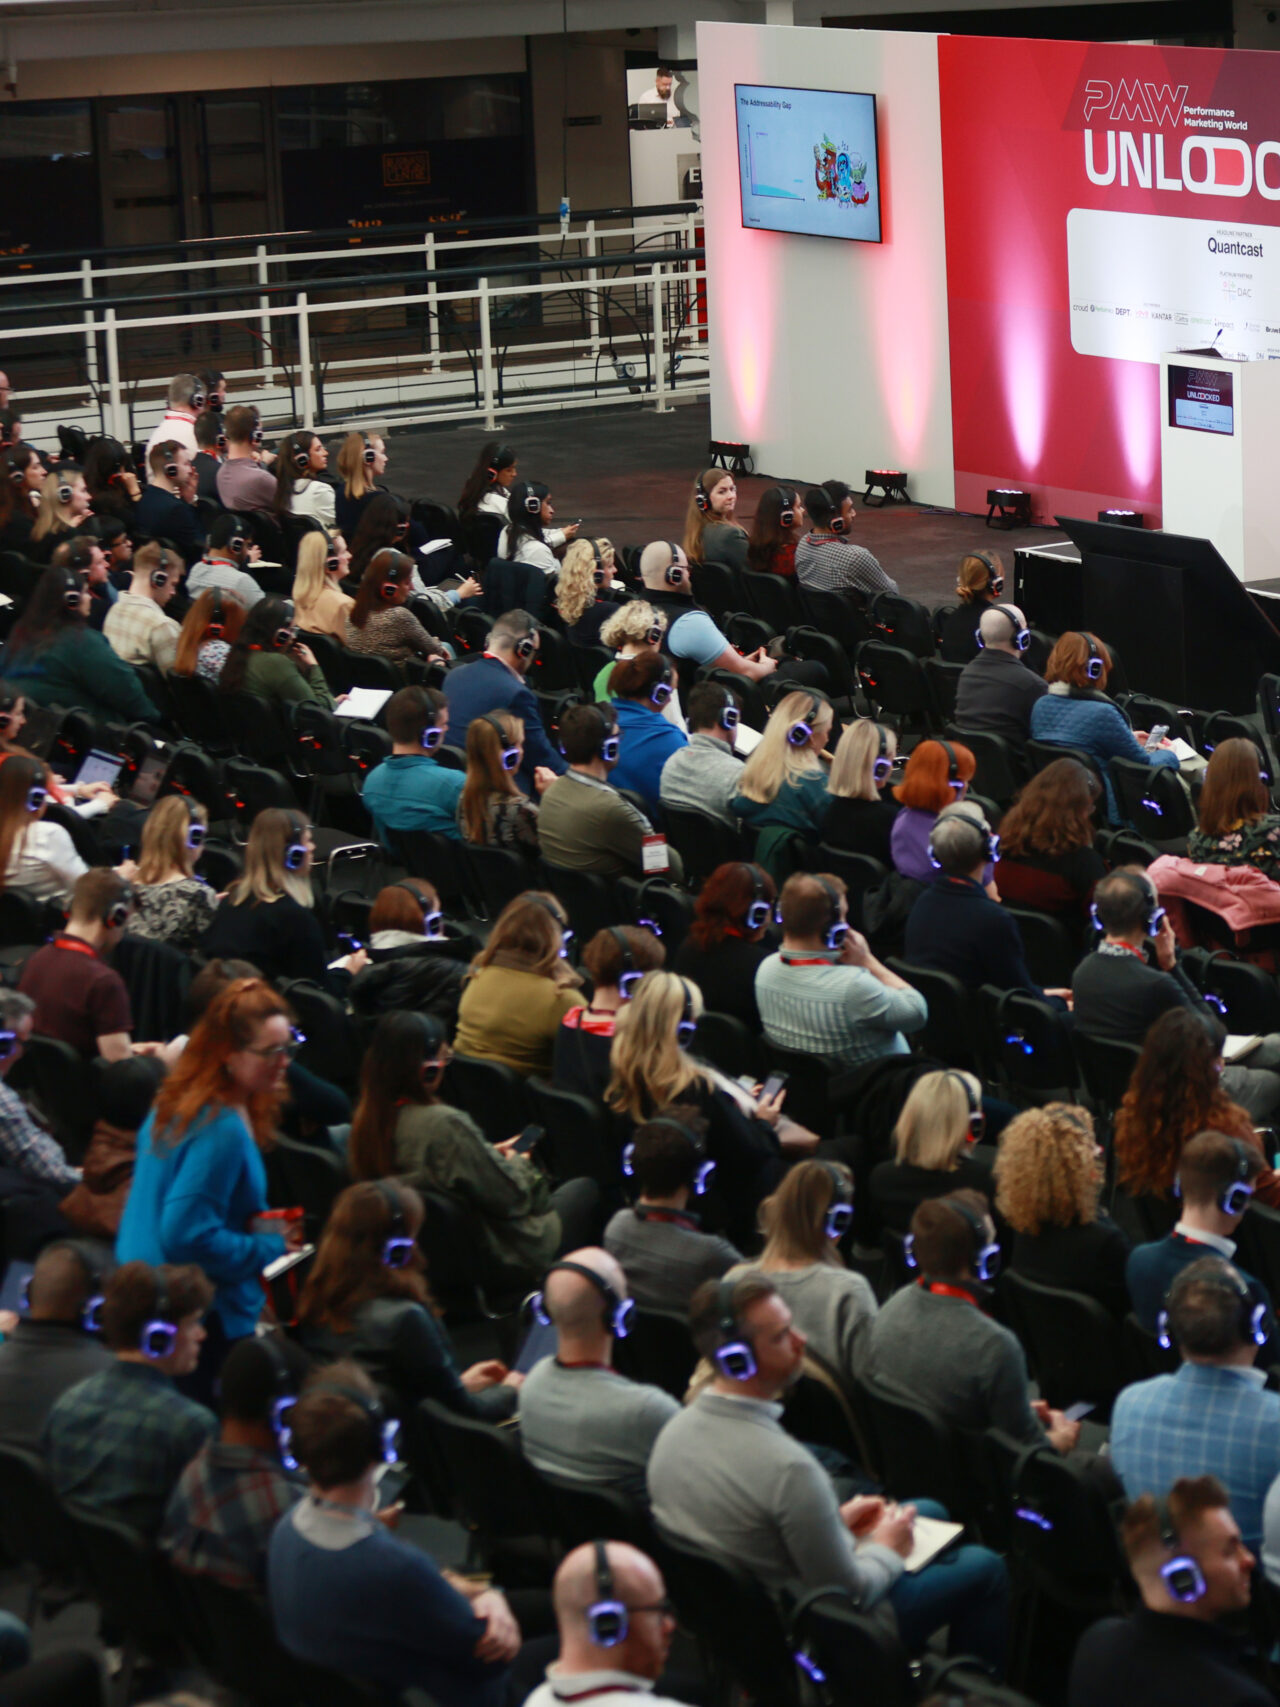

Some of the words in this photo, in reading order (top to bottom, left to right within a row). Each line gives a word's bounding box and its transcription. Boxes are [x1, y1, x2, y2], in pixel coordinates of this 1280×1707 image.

[782, 101, 792, 111] Gap
[1083, 78, 1188, 127] PMW
[1183, 105, 1235, 118] Performance
[1184, 117, 1223, 131] Marketing
[1224, 120, 1248, 131] World
[1208, 236, 1264, 258] Quantcast
